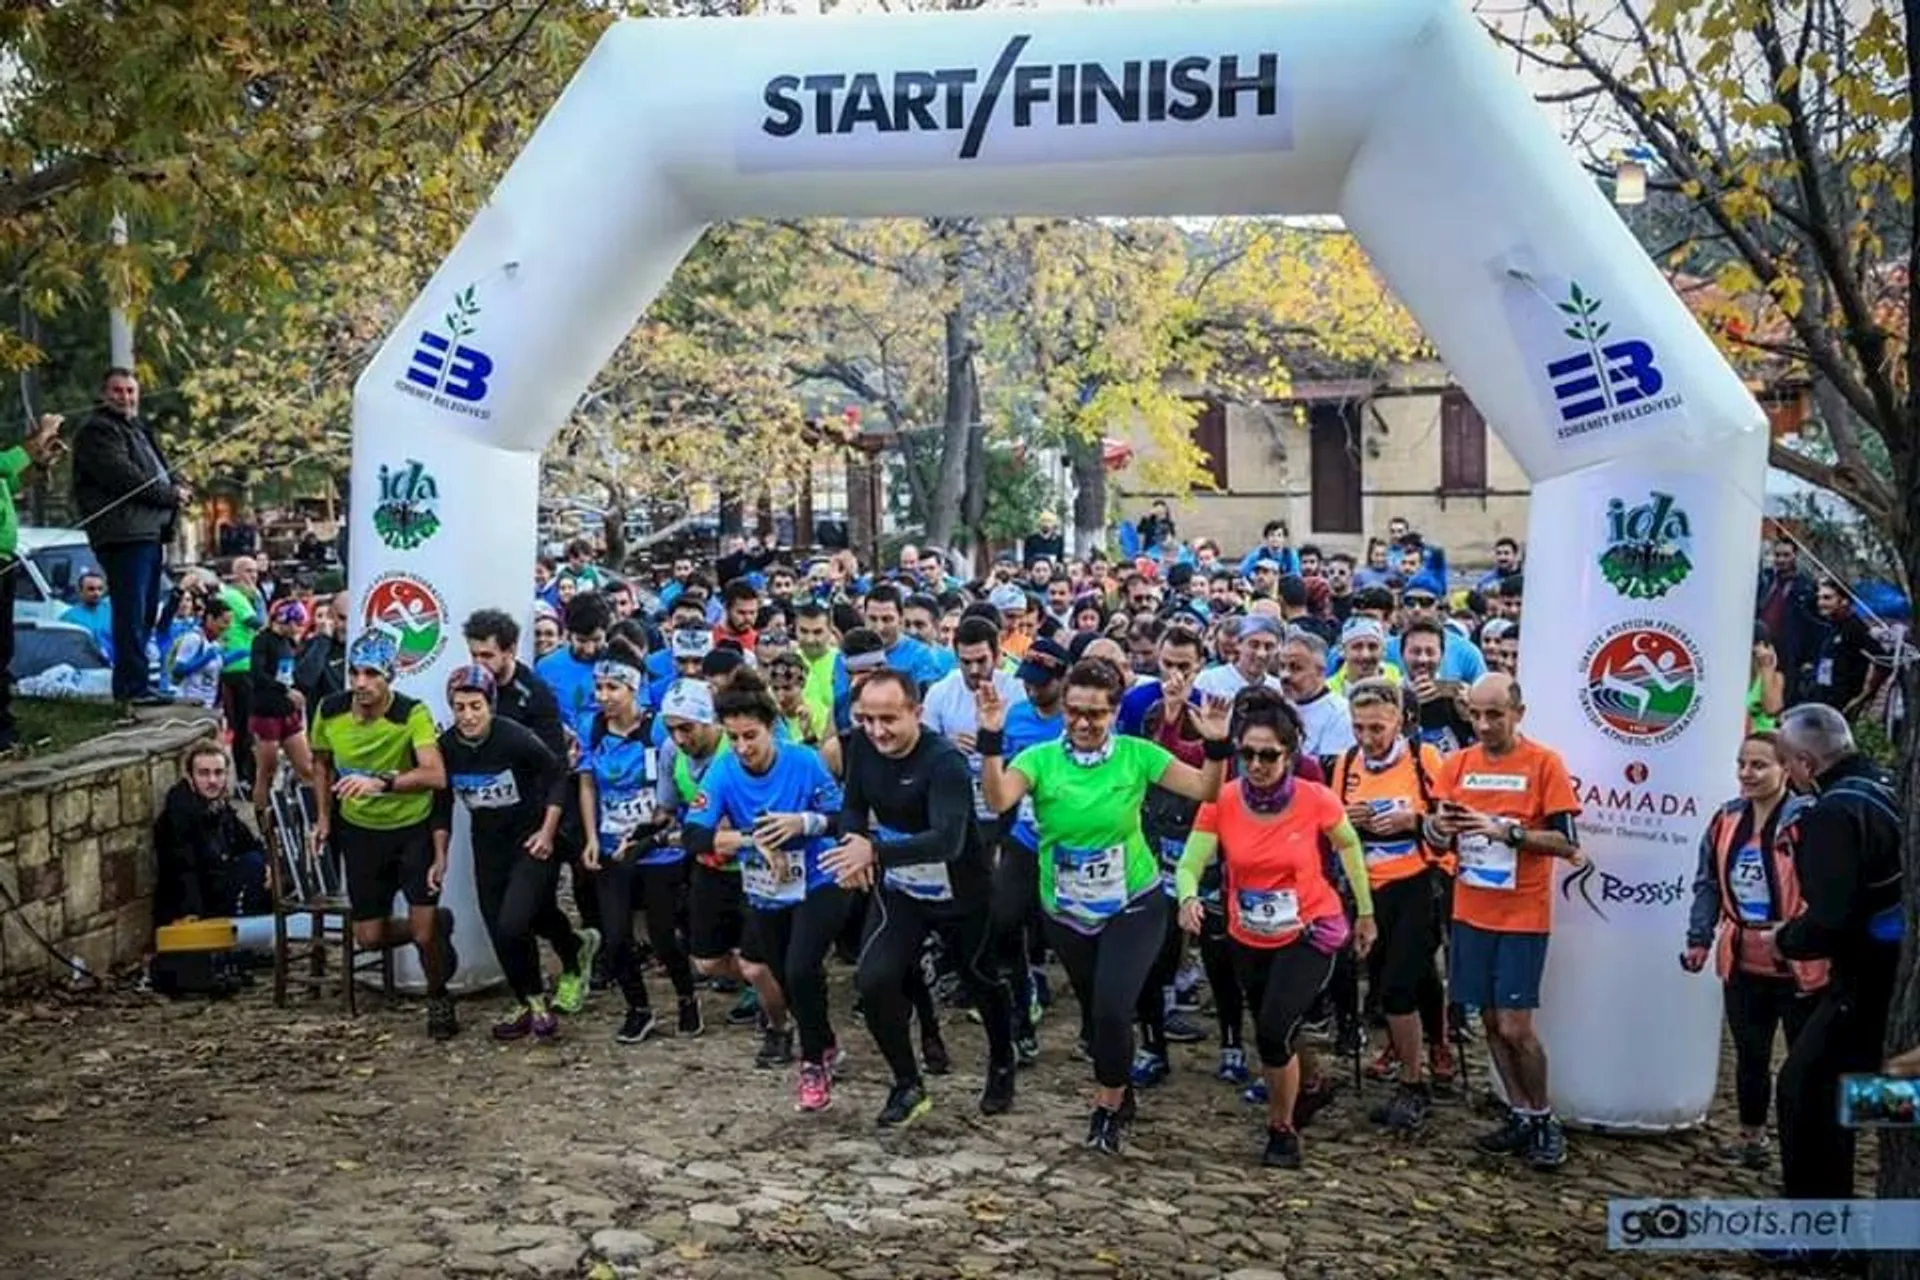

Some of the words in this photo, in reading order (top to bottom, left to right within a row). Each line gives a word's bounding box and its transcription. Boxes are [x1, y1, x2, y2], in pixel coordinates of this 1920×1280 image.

[762, 35, 1279, 159] START/FINISH
[1085, 862, 1111, 879] 17
[1739, 863, 1764, 881] 73
[1599, 871, 1685, 906] Rossist
[1262, 903, 1276, 918] 9
